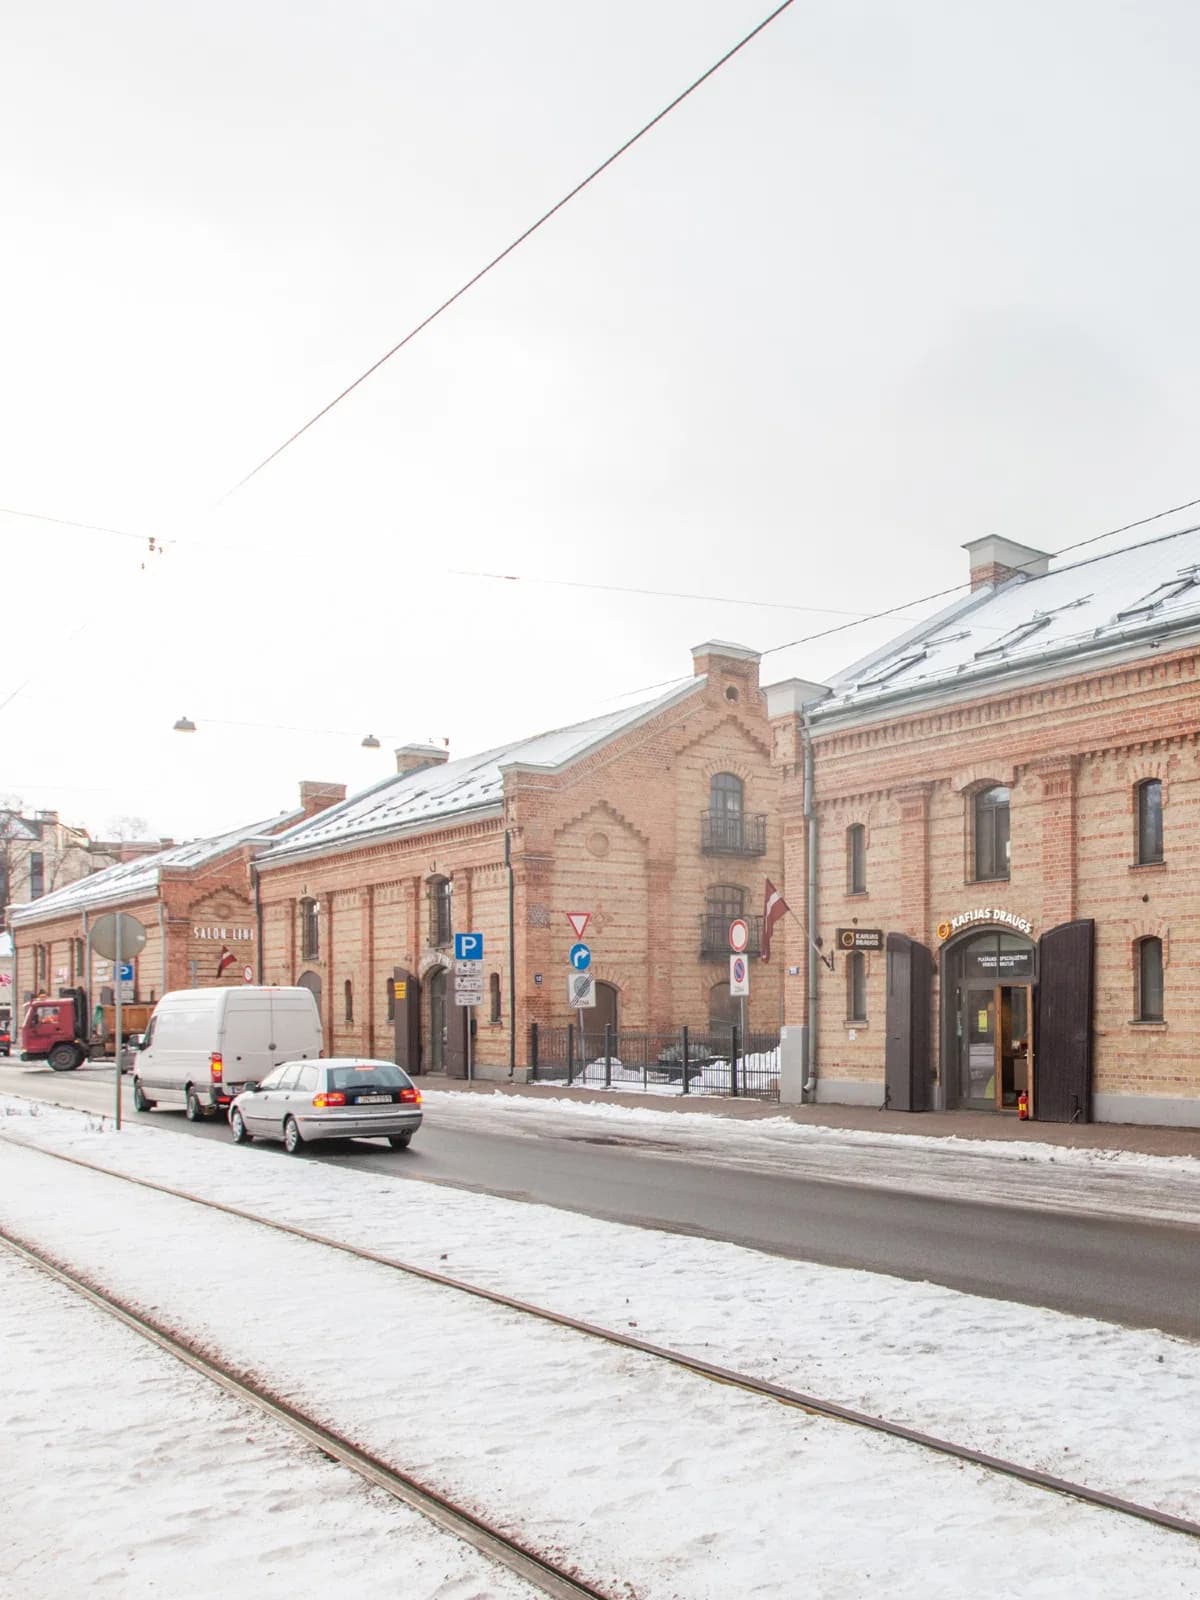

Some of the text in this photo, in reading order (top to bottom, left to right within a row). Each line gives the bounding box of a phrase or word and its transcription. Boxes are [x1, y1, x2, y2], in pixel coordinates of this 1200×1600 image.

[951, 908, 1032, 934] KAFIJAS DRAUGS
[193, 926, 227, 940] SALON
[461, 936, 477, 957] P
